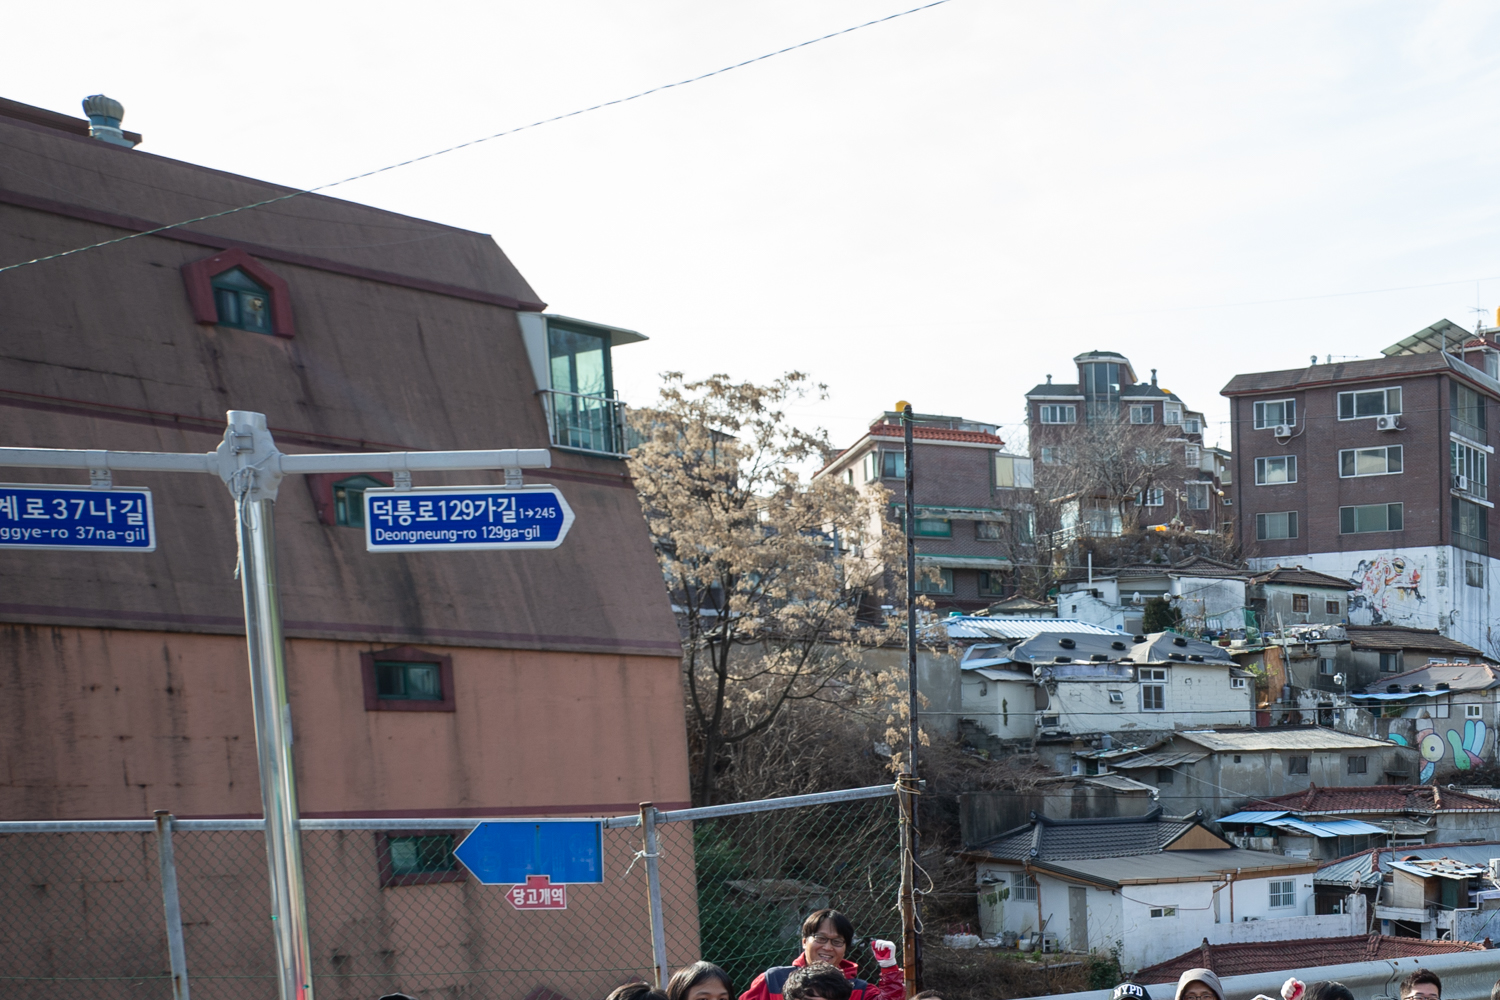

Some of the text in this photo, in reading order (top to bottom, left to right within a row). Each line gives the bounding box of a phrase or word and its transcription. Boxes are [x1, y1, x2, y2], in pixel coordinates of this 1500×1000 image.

[373, 497, 517, 526] 덕릉로129가길
[75, 526, 146, 543] 37na-gil
[375, 525, 540, 543] Deongneung-ro 129ga-gil
[512, 887, 564, 905] 당고개역
[1113, 983, 1143, 1000] NYPD
